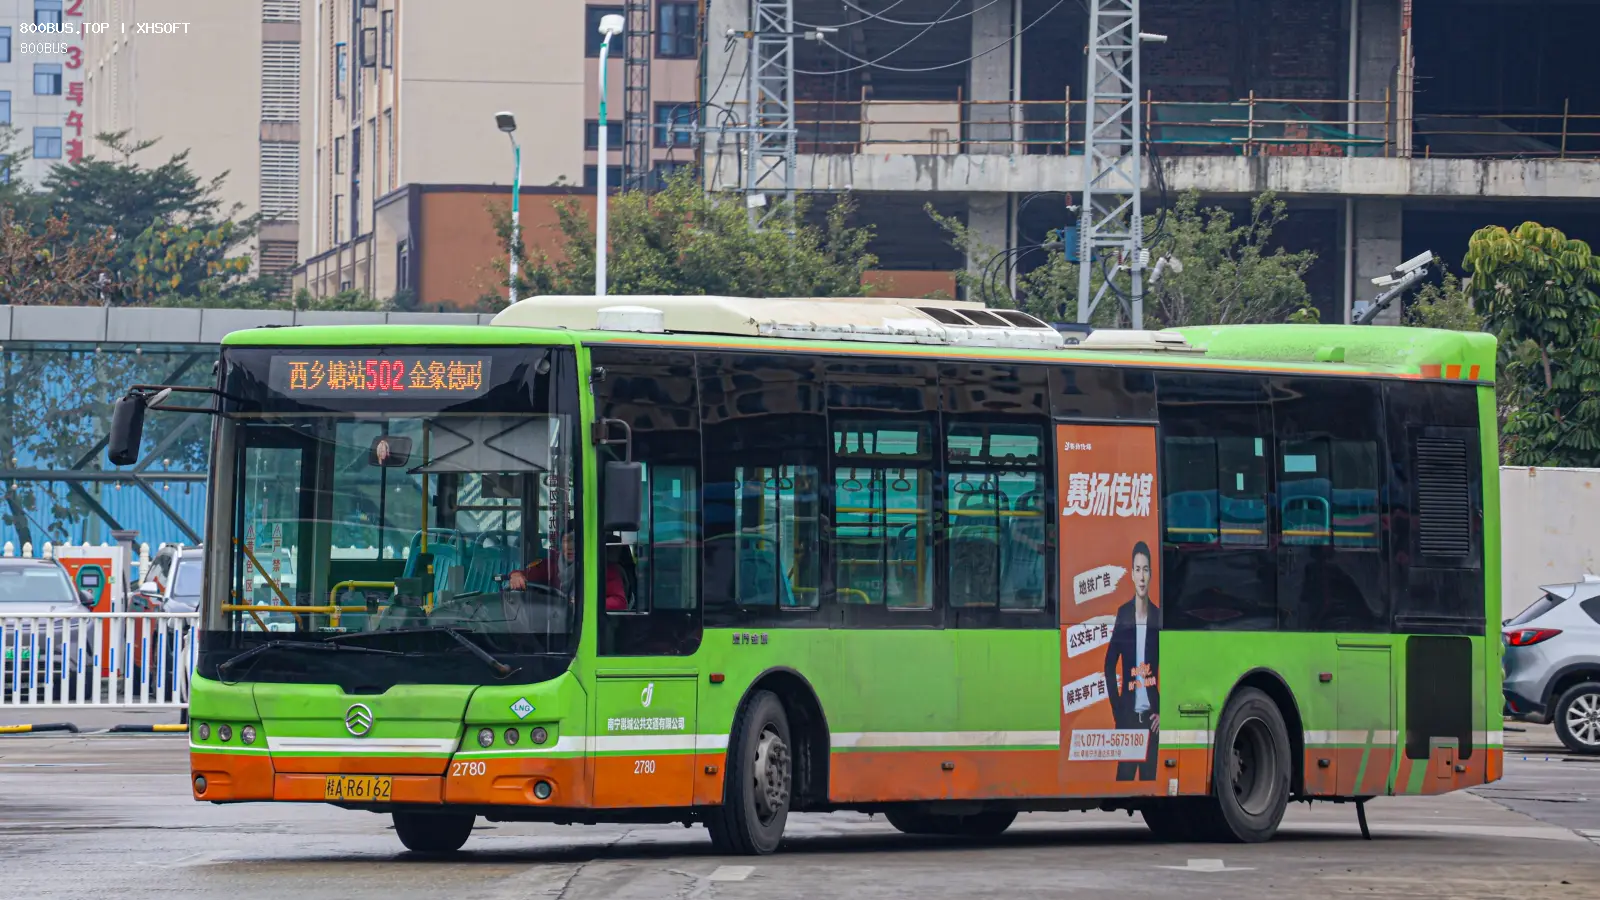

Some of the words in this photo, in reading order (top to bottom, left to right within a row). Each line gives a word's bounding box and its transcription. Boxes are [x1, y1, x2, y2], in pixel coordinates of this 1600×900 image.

[1062, 472, 1153, 517] 赛扬传媒
[1078, 572, 1111, 595] 地铁广告
[1069, 623, 1108, 649] 公交车广告
[1066, 680, 1106, 706] 候车亭广告
[514, 704, 530, 712] LNG
[1086, 733, 1144, 747] 0771-5675180
[452, 761, 486, 776] 2780
[633, 760, 656, 774] 2780
